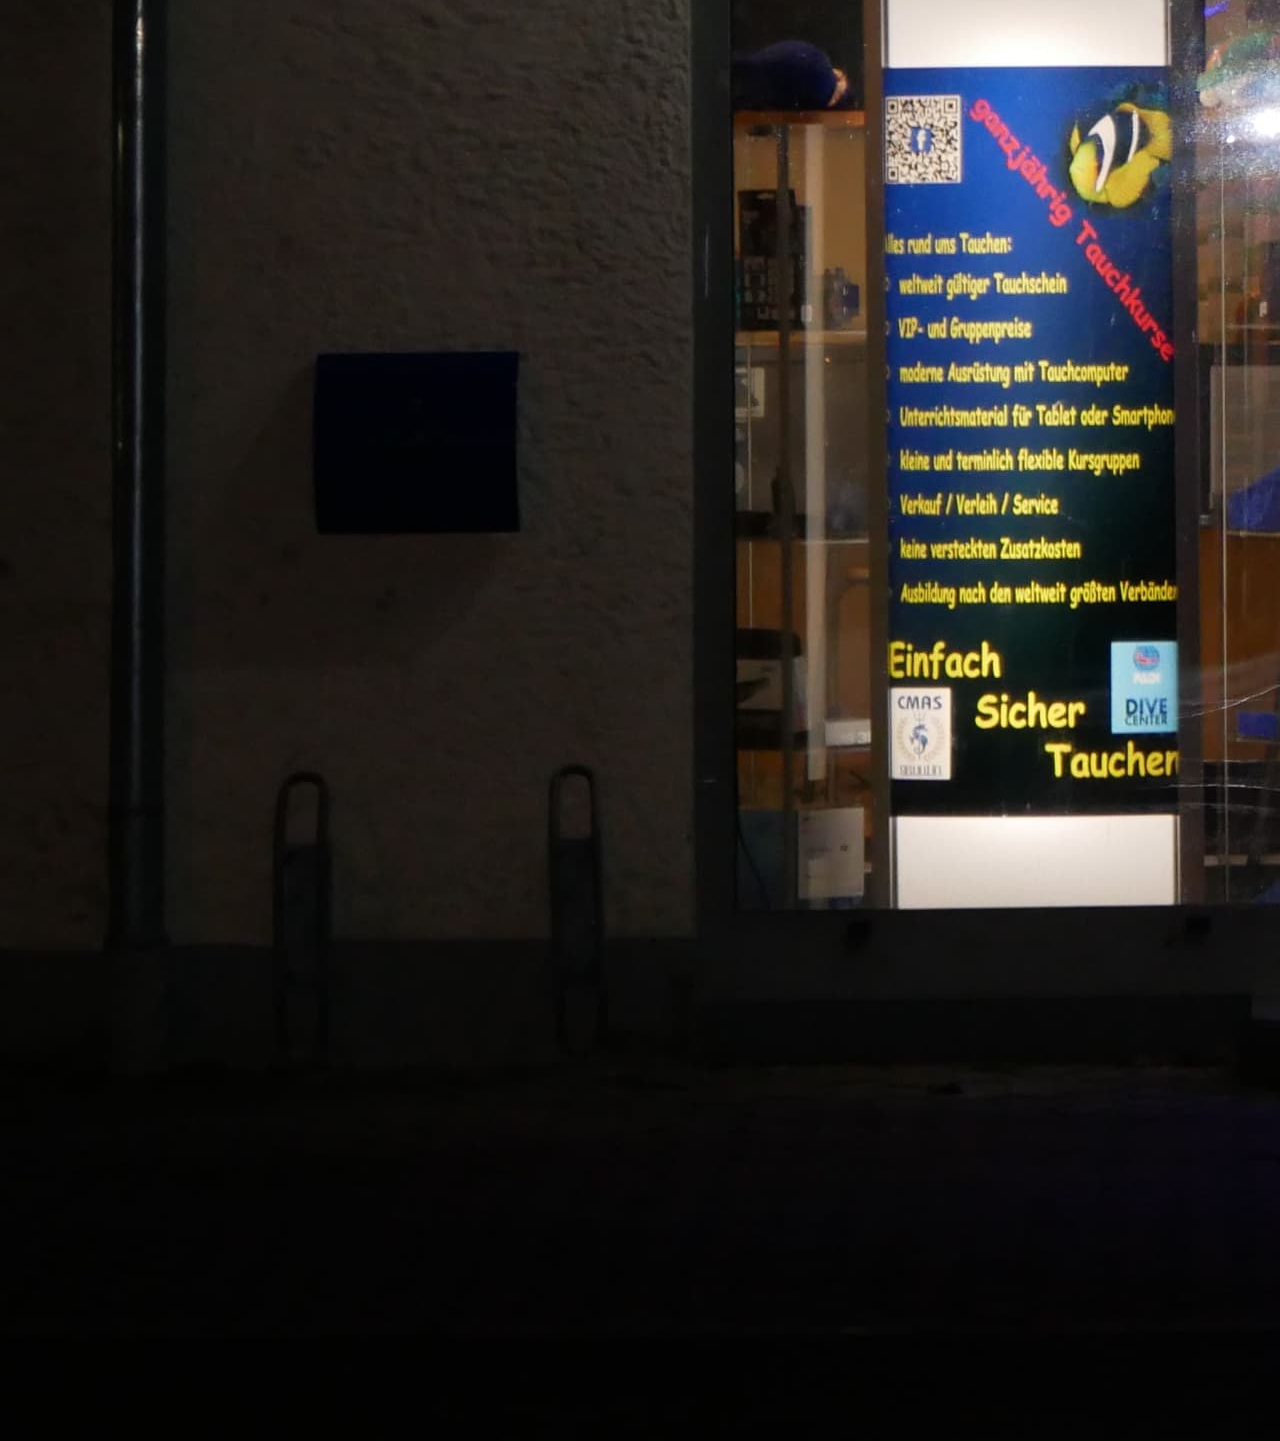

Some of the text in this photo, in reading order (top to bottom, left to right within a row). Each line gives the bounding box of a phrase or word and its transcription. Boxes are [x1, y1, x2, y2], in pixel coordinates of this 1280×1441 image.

[907, 232, 931, 254] rund
[935, 237, 956, 254] uns
[959, 231, 1012, 254] Tauchen:
[969, 99, 1176, 362] ganzjährig Tauchkurse
[899, 271, 1067, 300] weltweit gültiger Tauchschein
[898, 316, 1032, 344] VIP- und Gruppenpreise
[900, 360, 1129, 388] moderne Ausrüstung mit Tauchcomputer
[900, 405, 1007, 427] Unterrichtsmaterial
[1012, 404, 1032, 428] für
[1036, 403, 1076, 426] Tablet
[1080, 403, 1108, 426] oder
[900, 448, 1140, 476] kleine und terminlich flexible Kursgruppen
[900, 493, 943, 516] Verkauf
[956, 493, 997, 515] Verleih
[1013, 493, 1059, 515] Service
[900, 537, 1082, 559] keine versteckten Zusatzkosten
[901, 582, 956, 609] Ausbildung
[959, 581, 985, 603] nach
[989, 581, 1011, 603] den
[1015, 581, 1066, 603] weltweit
[1070, 580, 1116, 609] größten
[888, 640, 1001, 680] Einfach
[897, 695, 942, 710] CMAS
[975, 691, 1086, 730] Sicher
[1126, 697, 1168, 716] DIVE
[1124, 714, 1168, 726] CENTER
[1044, 740, 1179, 779] Tauchen
